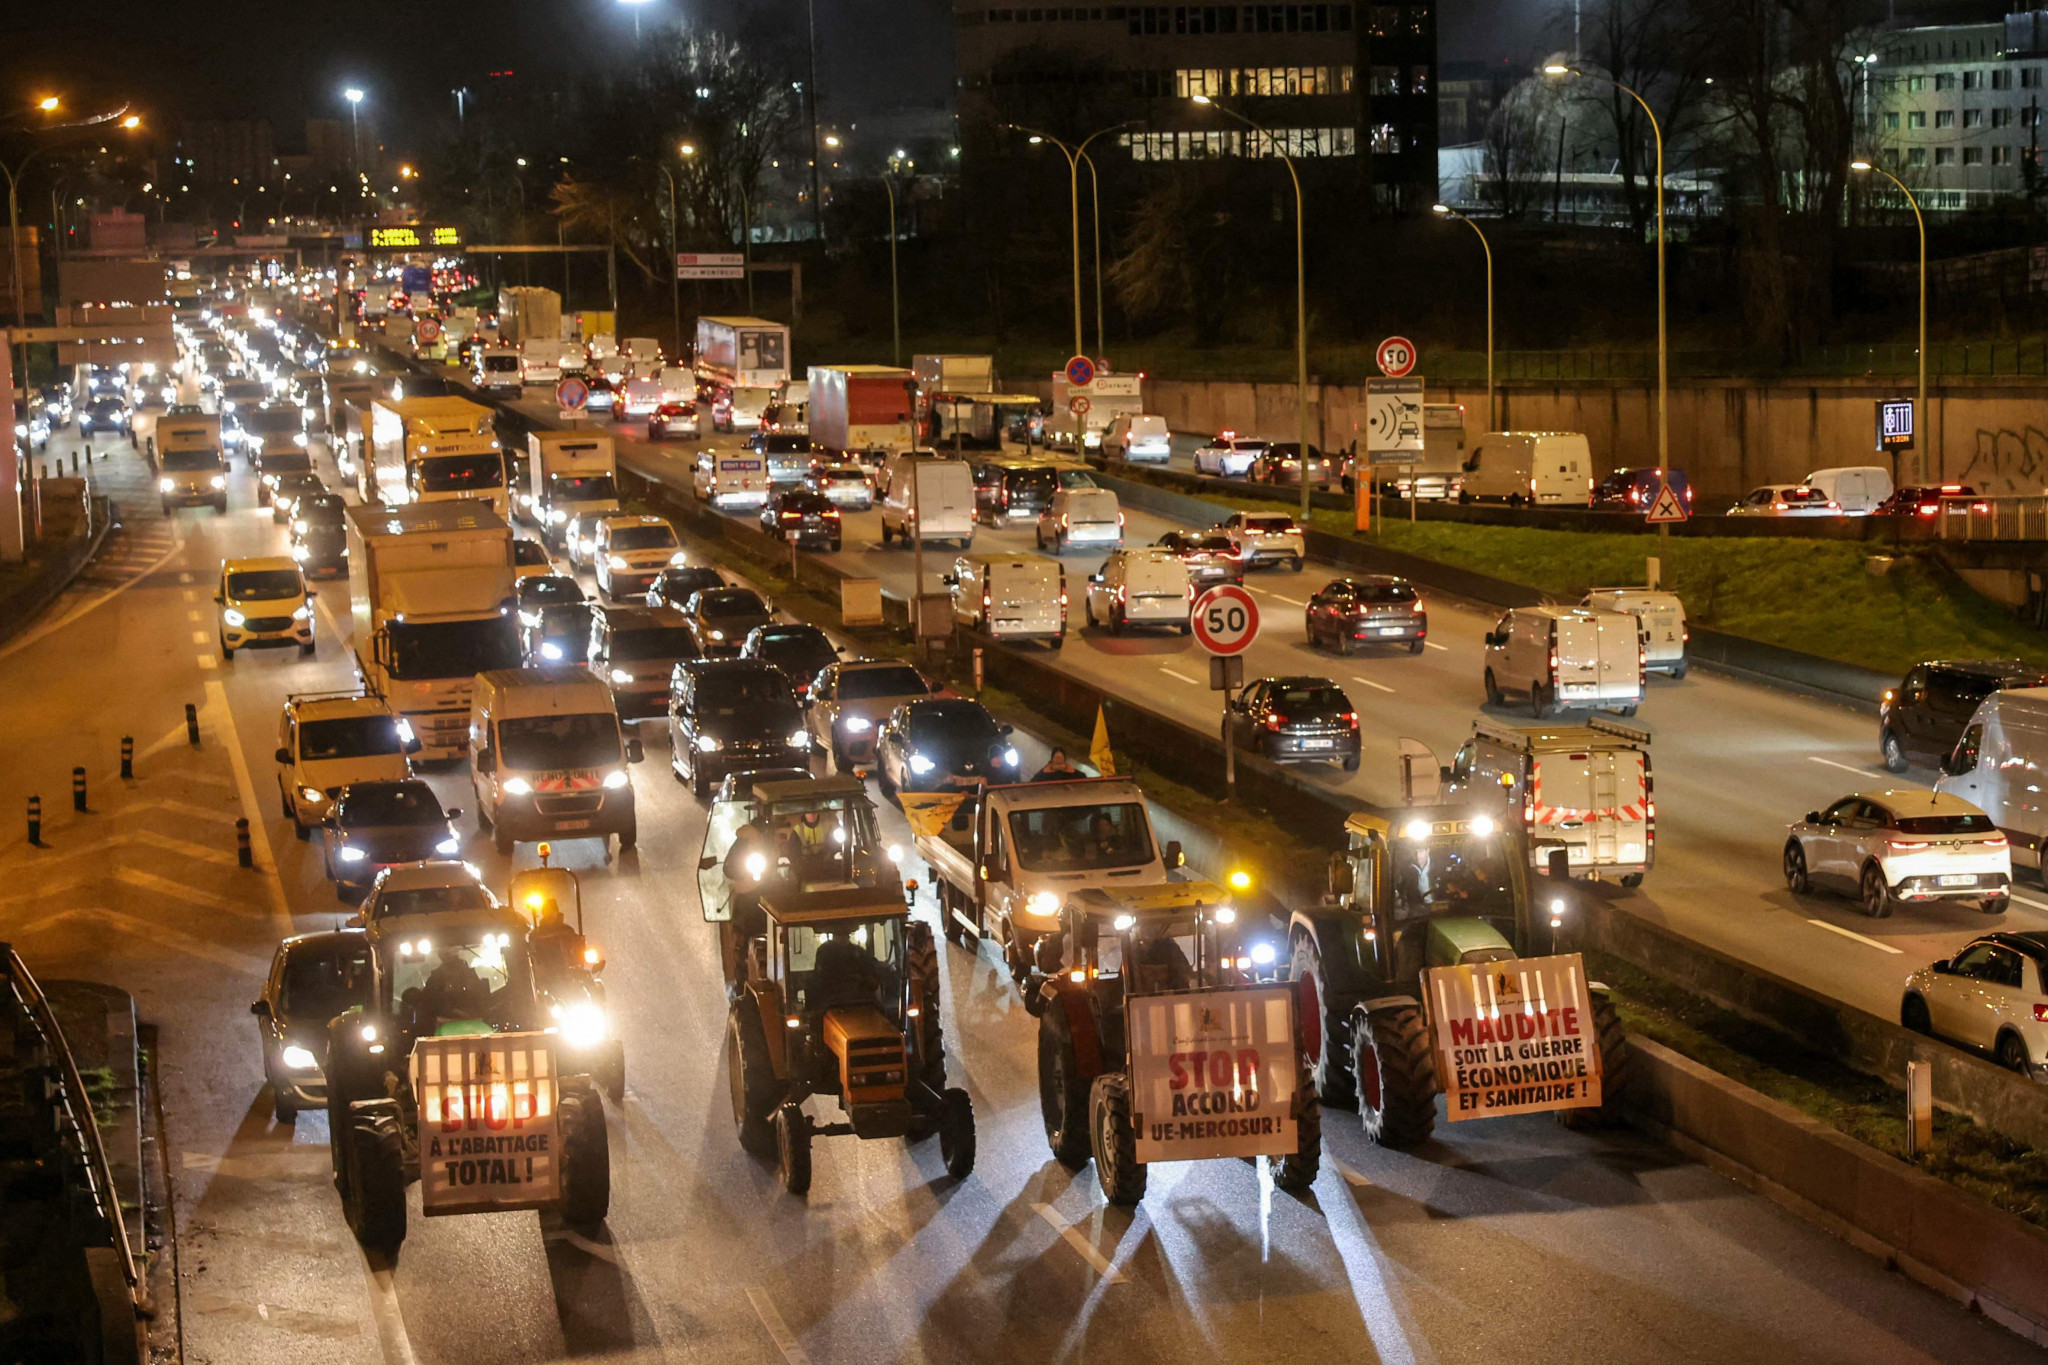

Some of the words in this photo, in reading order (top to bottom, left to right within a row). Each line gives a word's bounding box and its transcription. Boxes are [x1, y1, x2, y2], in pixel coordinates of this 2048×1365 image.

[1208, 607, 1245, 633] 50
[1450, 1007, 1580, 1046] MAUDITE
[1455, 1048, 1488, 1066] SOIT
[1494, 1045, 1515, 1062] LA
[1519, 1038, 1583, 1059] GUERRE
[1168, 1049, 1260, 1090] STOP
[1457, 1058, 1588, 1090] ÉCONOMIQUE
[1172, 1090, 1260, 1117] ACCORD
[1460, 1091, 1479, 1111] ET
[1485, 1082, 1575, 1108] SANITAIRE
[441, 1093, 537, 1133] STOP
[1151, 1118, 1273, 1141] UE-MERCOSUR
[430, 1136, 443, 1157] À
[448, 1134, 549, 1156] L'ABATTAGE
[445, 1158, 520, 1186] TOTAL
